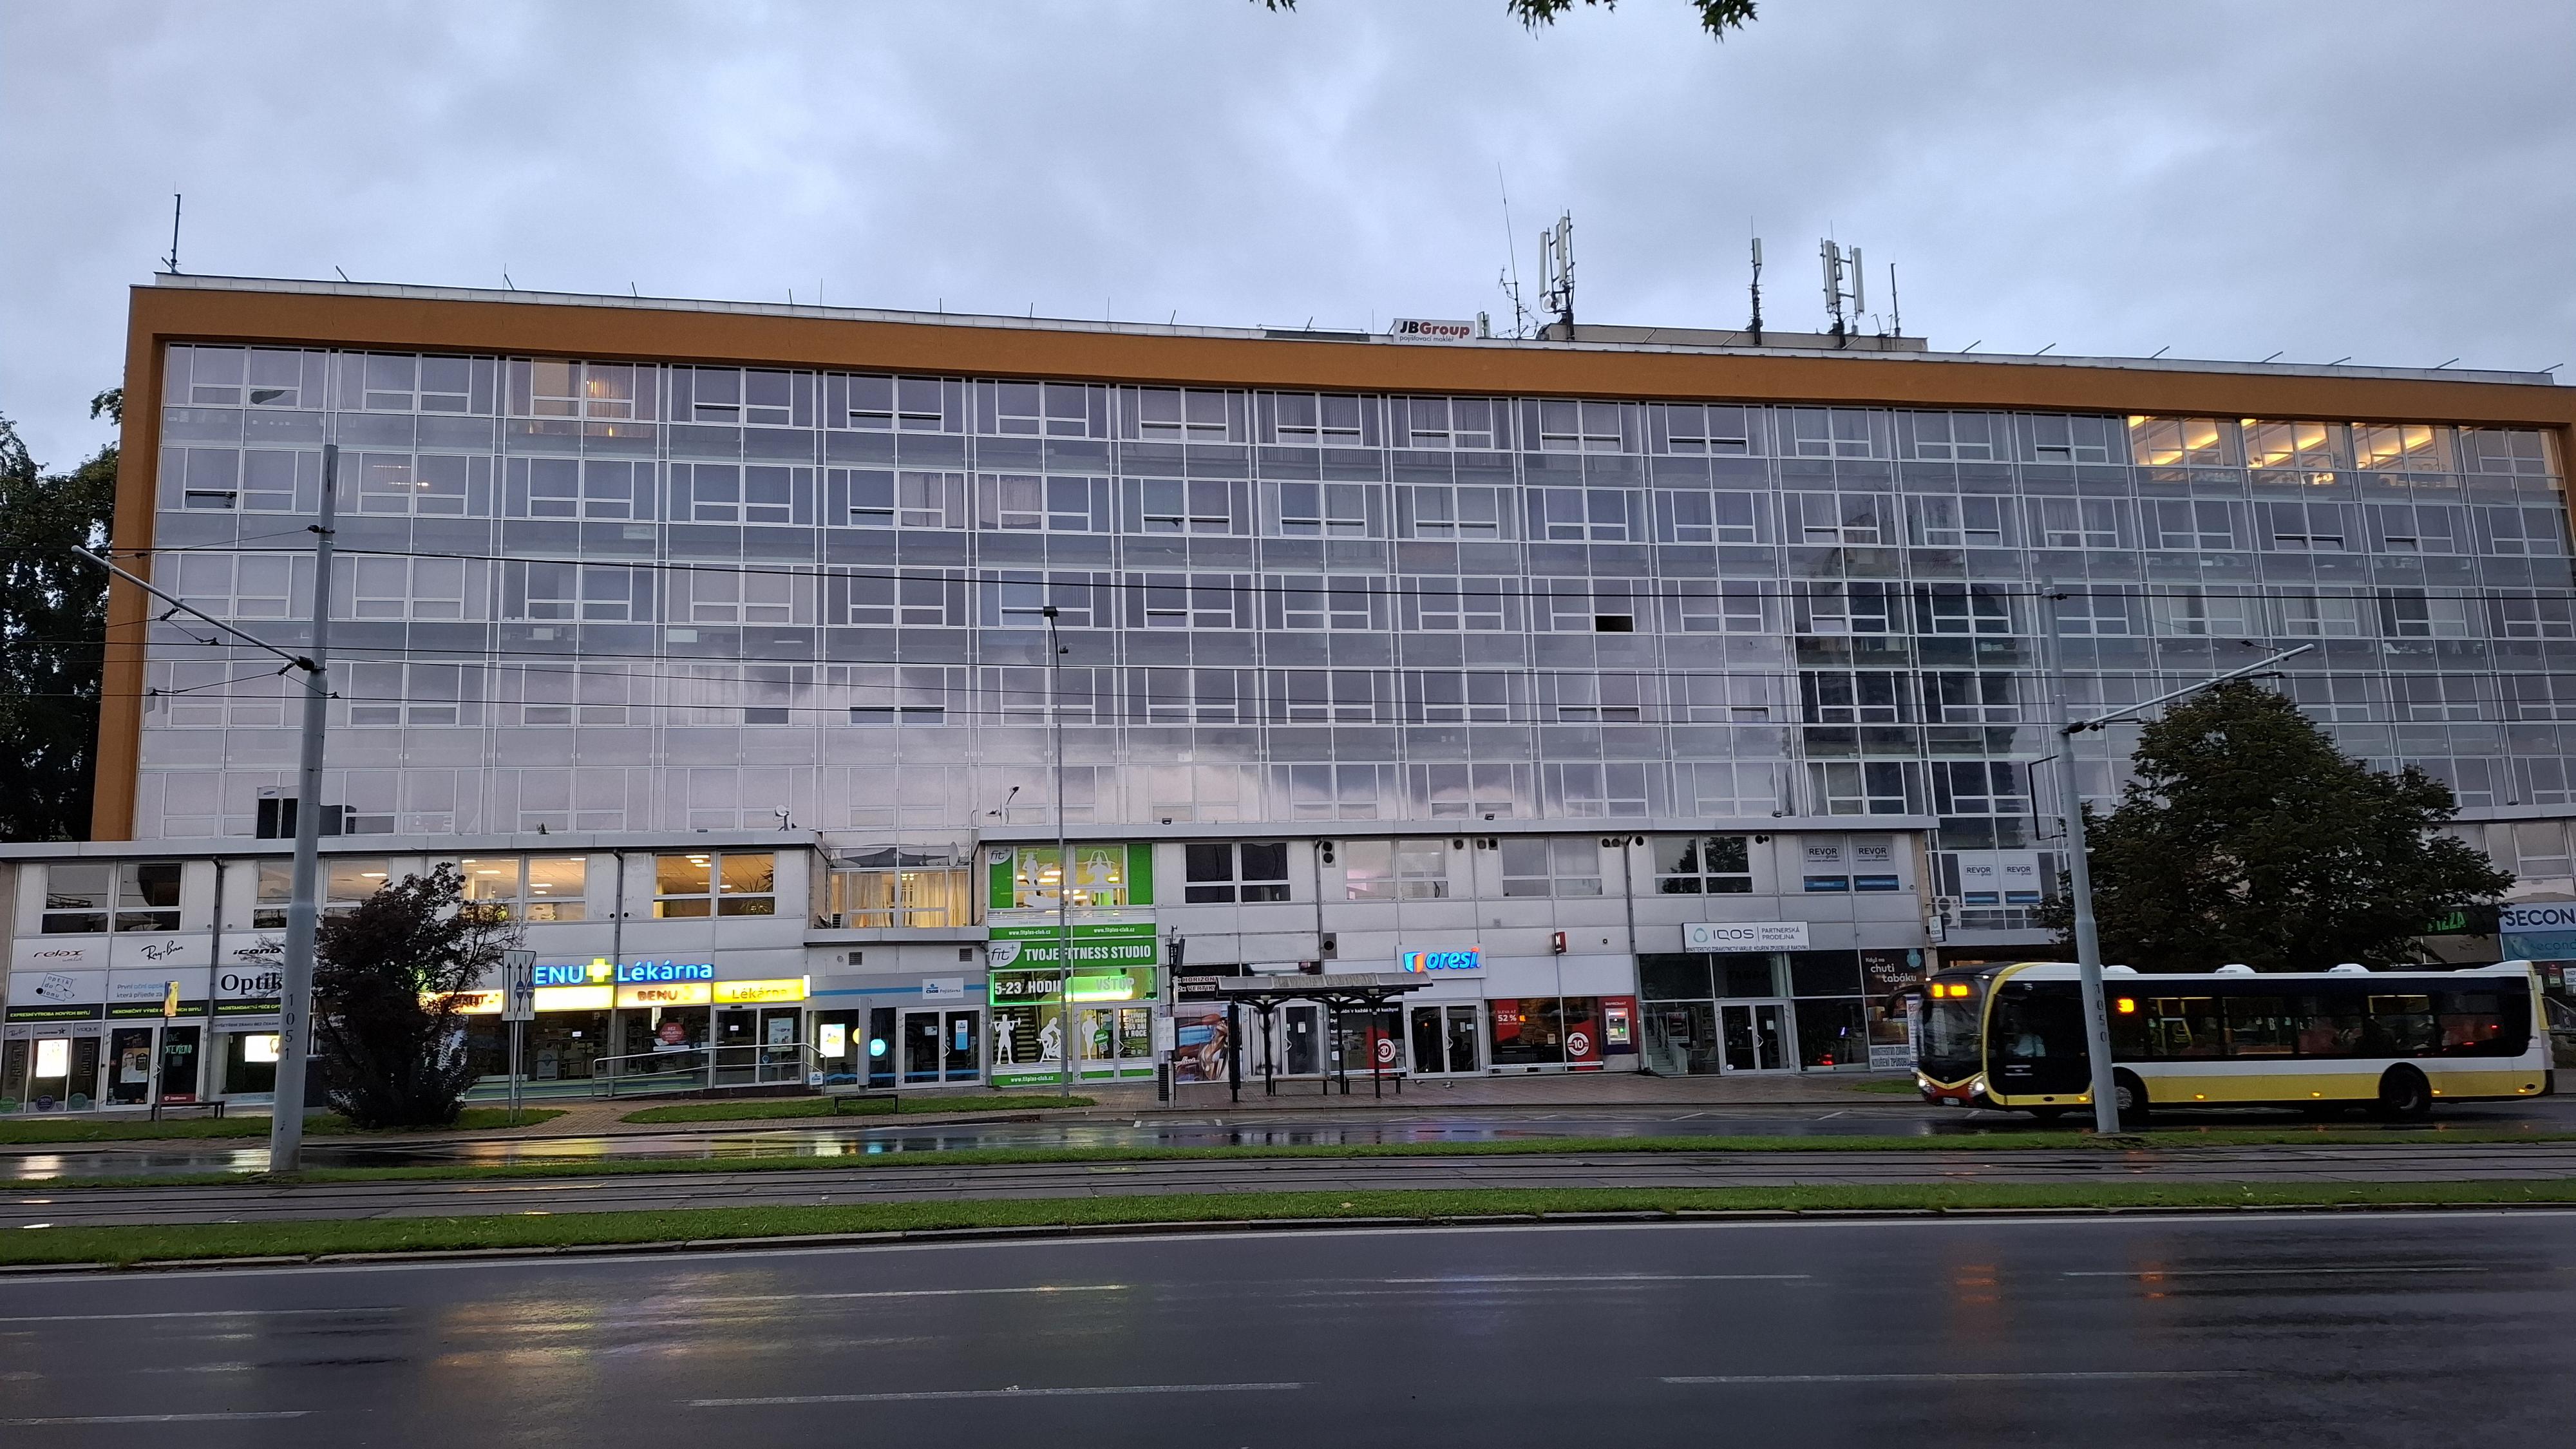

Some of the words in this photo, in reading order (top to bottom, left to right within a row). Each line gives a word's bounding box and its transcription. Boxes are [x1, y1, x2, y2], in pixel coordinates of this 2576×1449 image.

[1400, 321, 1470, 339] JBGroup
[1713, 929, 1754, 940] IQOS
[33, 949, 86, 958] relax
[141, 940, 184, 960] Ray-Ban
[1025, 948, 1059, 961] TVOJE
[1111, 945, 1151, 958] STUDIO
[535, 965, 584, 985] ENU
[617, 960, 714, 982] Lékárna
[1870, 963, 1895, 973] chuti
[48, 976, 70, 985] optik
[1882, 973, 1917, 983] tabáku
[994, 981, 1021, 995] 5-23
[1095, 978, 1135, 990] VSTUP
[638, 990, 677, 1001] BENU
[284, 994, 294, 1060] 1051
[1573, 1039, 1584, 1049] 10
